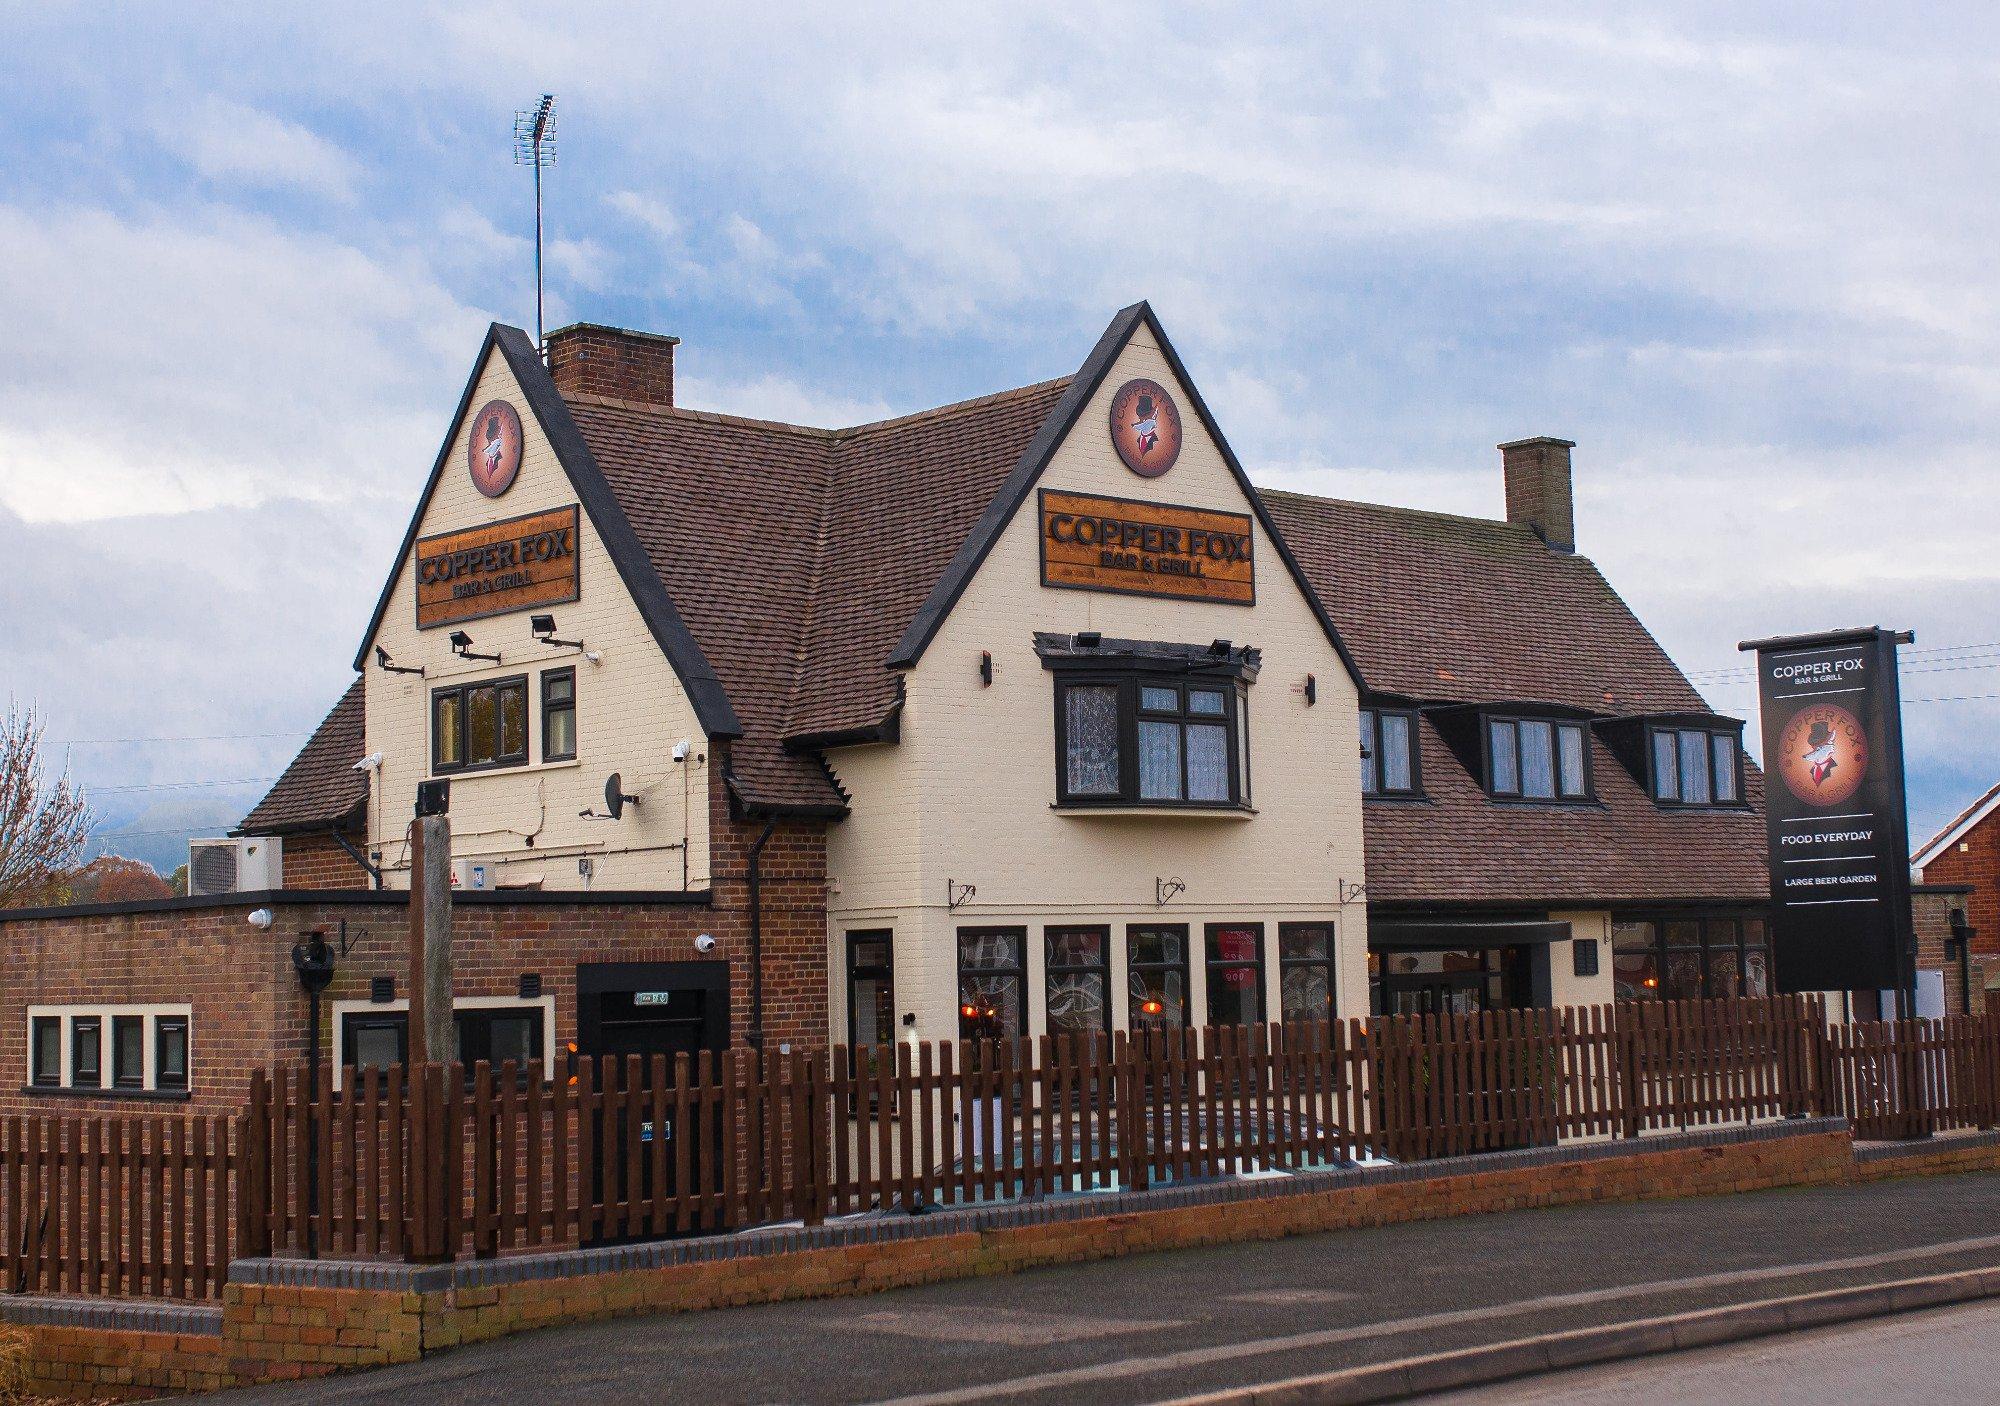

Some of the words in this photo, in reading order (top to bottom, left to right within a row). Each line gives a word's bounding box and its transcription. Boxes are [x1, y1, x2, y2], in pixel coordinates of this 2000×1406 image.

[1116, 385, 1157, 419] COPPER
[1052, 514, 1182, 554] COPPER
[1188, 530, 1251, 562] FOX
[418, 541, 514, 584] COPPER
[519, 528, 569, 563] FOX
[1100, 551, 1138, 569] BAR
[1141, 556, 1155, 572] &
[1157, 557, 1206, 578] GRILL
[452, 582, 479, 599] BAR
[481, 579, 492, 593] &
[494, 569, 533, 591] GRILL
[1773, 662, 1832, 679] COPPER
[1835, 658, 1864, 672] FOX
[1794, 677, 1812, 685] BAR
[1820, 673, 1843, 682] GRILL
[1785, 709, 1835, 754] COPPER
[1837, 716, 1861, 747] FOX
[1781, 834, 1813, 845] FOOD
[1814, 830, 1873, 843] EVERYDAY
[1784, 879, 1814, 887] LARGE
[1815, 876, 1838, 885] BEER
[1839, 874, 1877, 884] GARDEN
